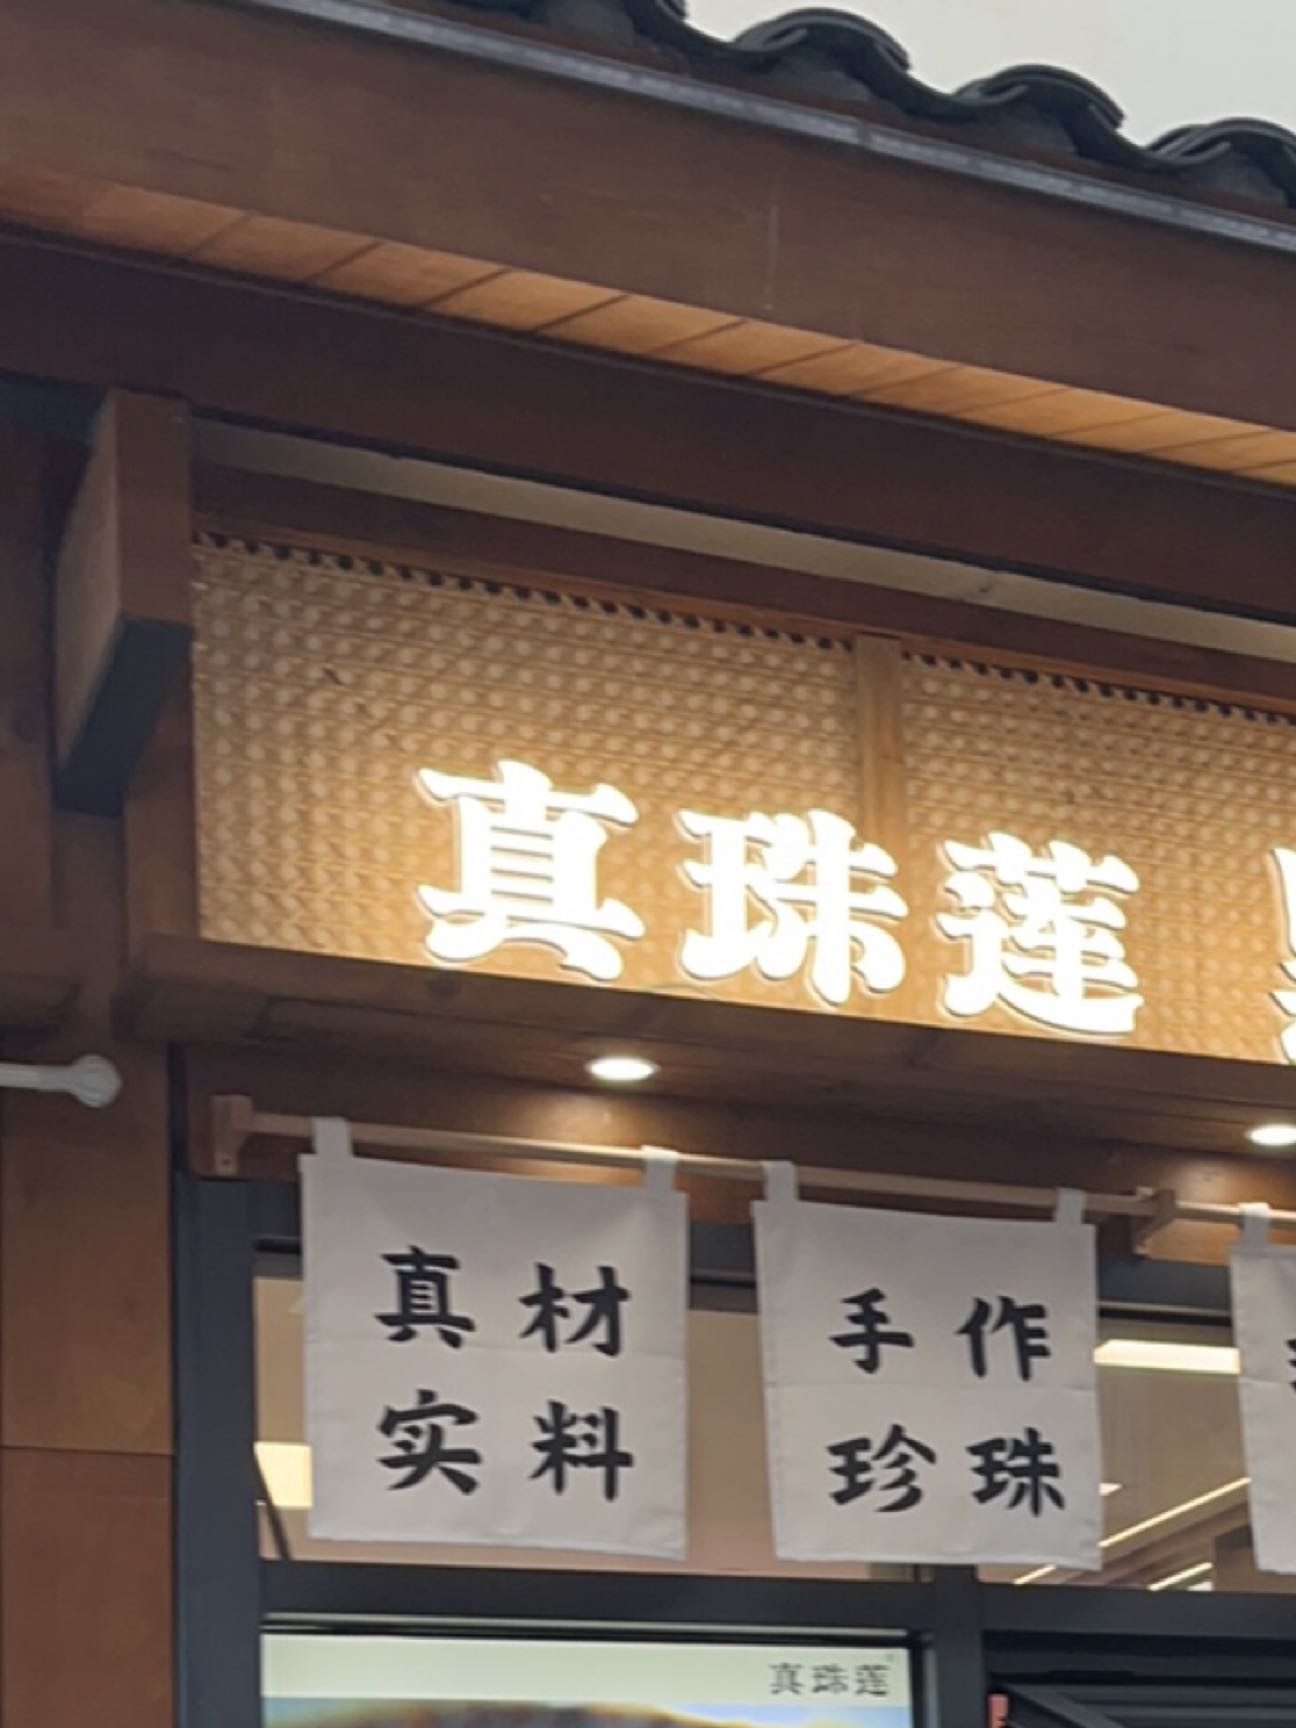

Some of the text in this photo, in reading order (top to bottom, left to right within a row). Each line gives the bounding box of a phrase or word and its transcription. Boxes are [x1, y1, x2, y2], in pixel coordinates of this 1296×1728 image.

[416, 760, 1145, 1036] 真珠莲
[375, 1245, 632, 1357] 真材
[830, 1288, 1052, 1381] 手作
[376, 1390, 634, 1501] 实料
[826, 1423, 1066, 1517] 珍珠
